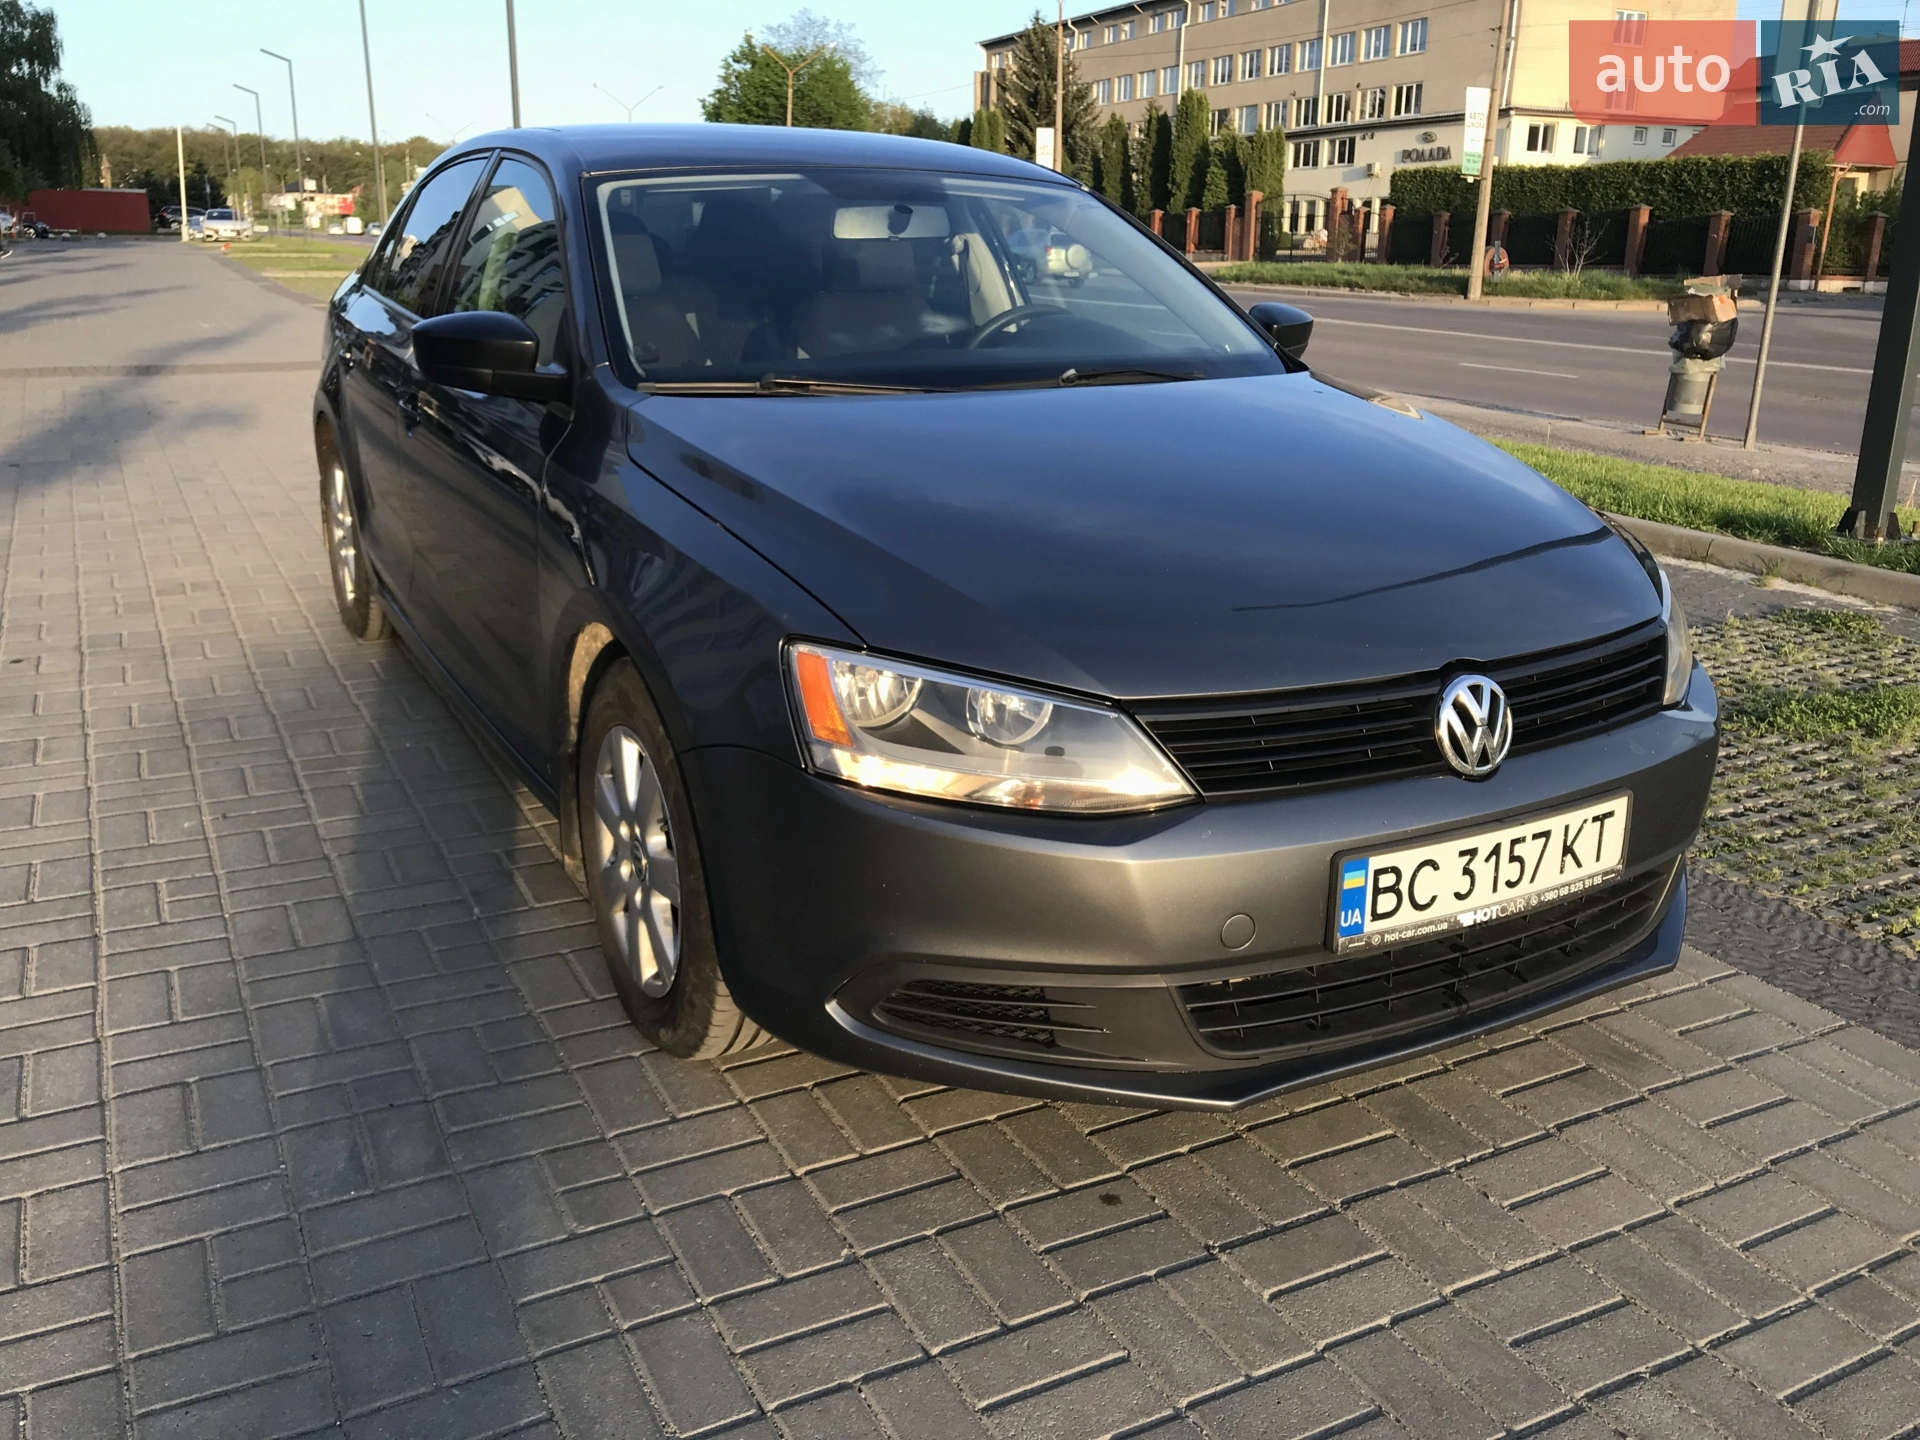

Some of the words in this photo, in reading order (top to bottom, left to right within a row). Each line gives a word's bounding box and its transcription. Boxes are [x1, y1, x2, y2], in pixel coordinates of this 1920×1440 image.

[1370, 858, 1440, 923] BC
[1453, 829, 1552, 901] 3157
[1560, 809, 1615, 875] KT
[1340, 908, 1362, 927] UA
[1384, 921, 1448, 942] hot-car.com.ua
